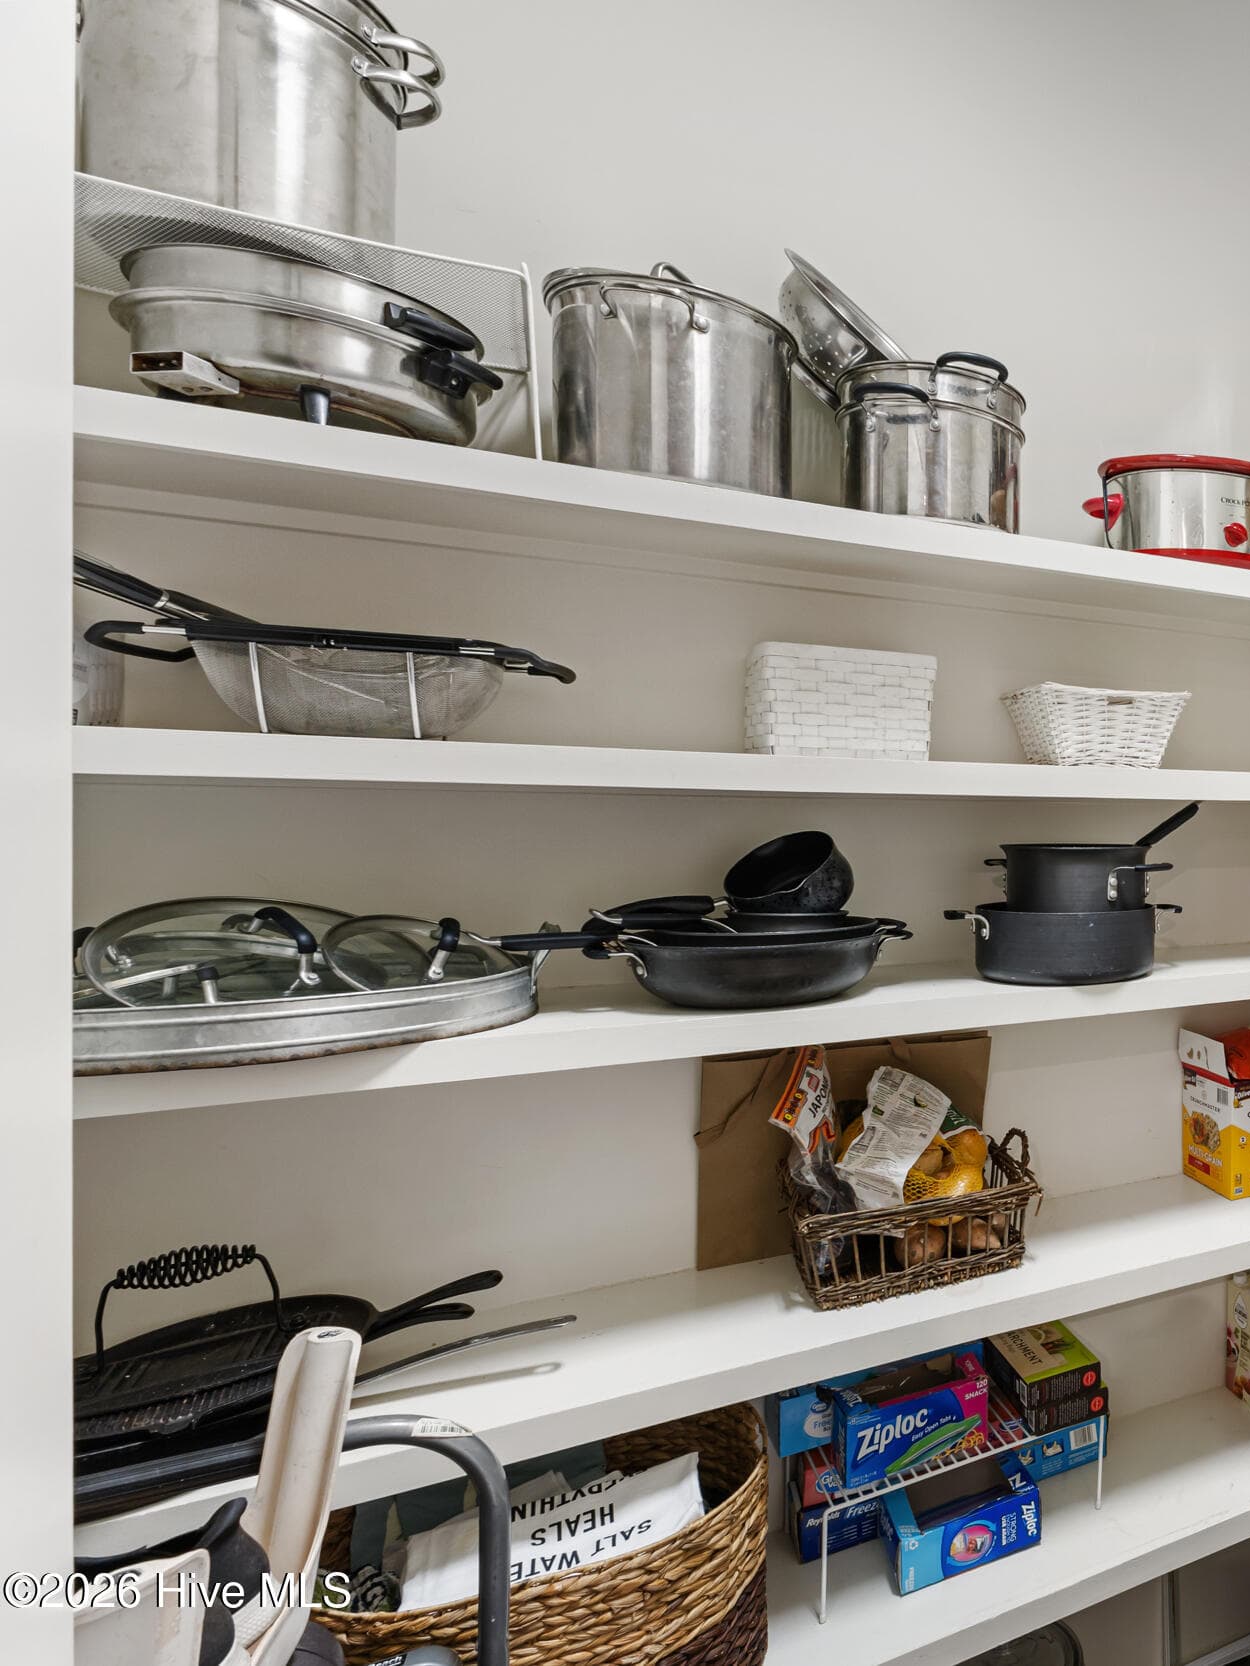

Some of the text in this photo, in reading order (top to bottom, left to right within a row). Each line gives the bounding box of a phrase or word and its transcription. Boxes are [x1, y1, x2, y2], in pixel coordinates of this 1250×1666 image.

[964, 1388, 988, 1400] SNACK
[976, 1379, 988, 1389] 120
[857, 1409, 928, 1461] Ziploc
[911, 1415, 951, 1442] Easy Open Tabs
[530, 1503, 615, 1547] HEALS
[1021, 1501, 1038, 1537] Ziploc
[511, 1519, 652, 1583] SALT WATE
